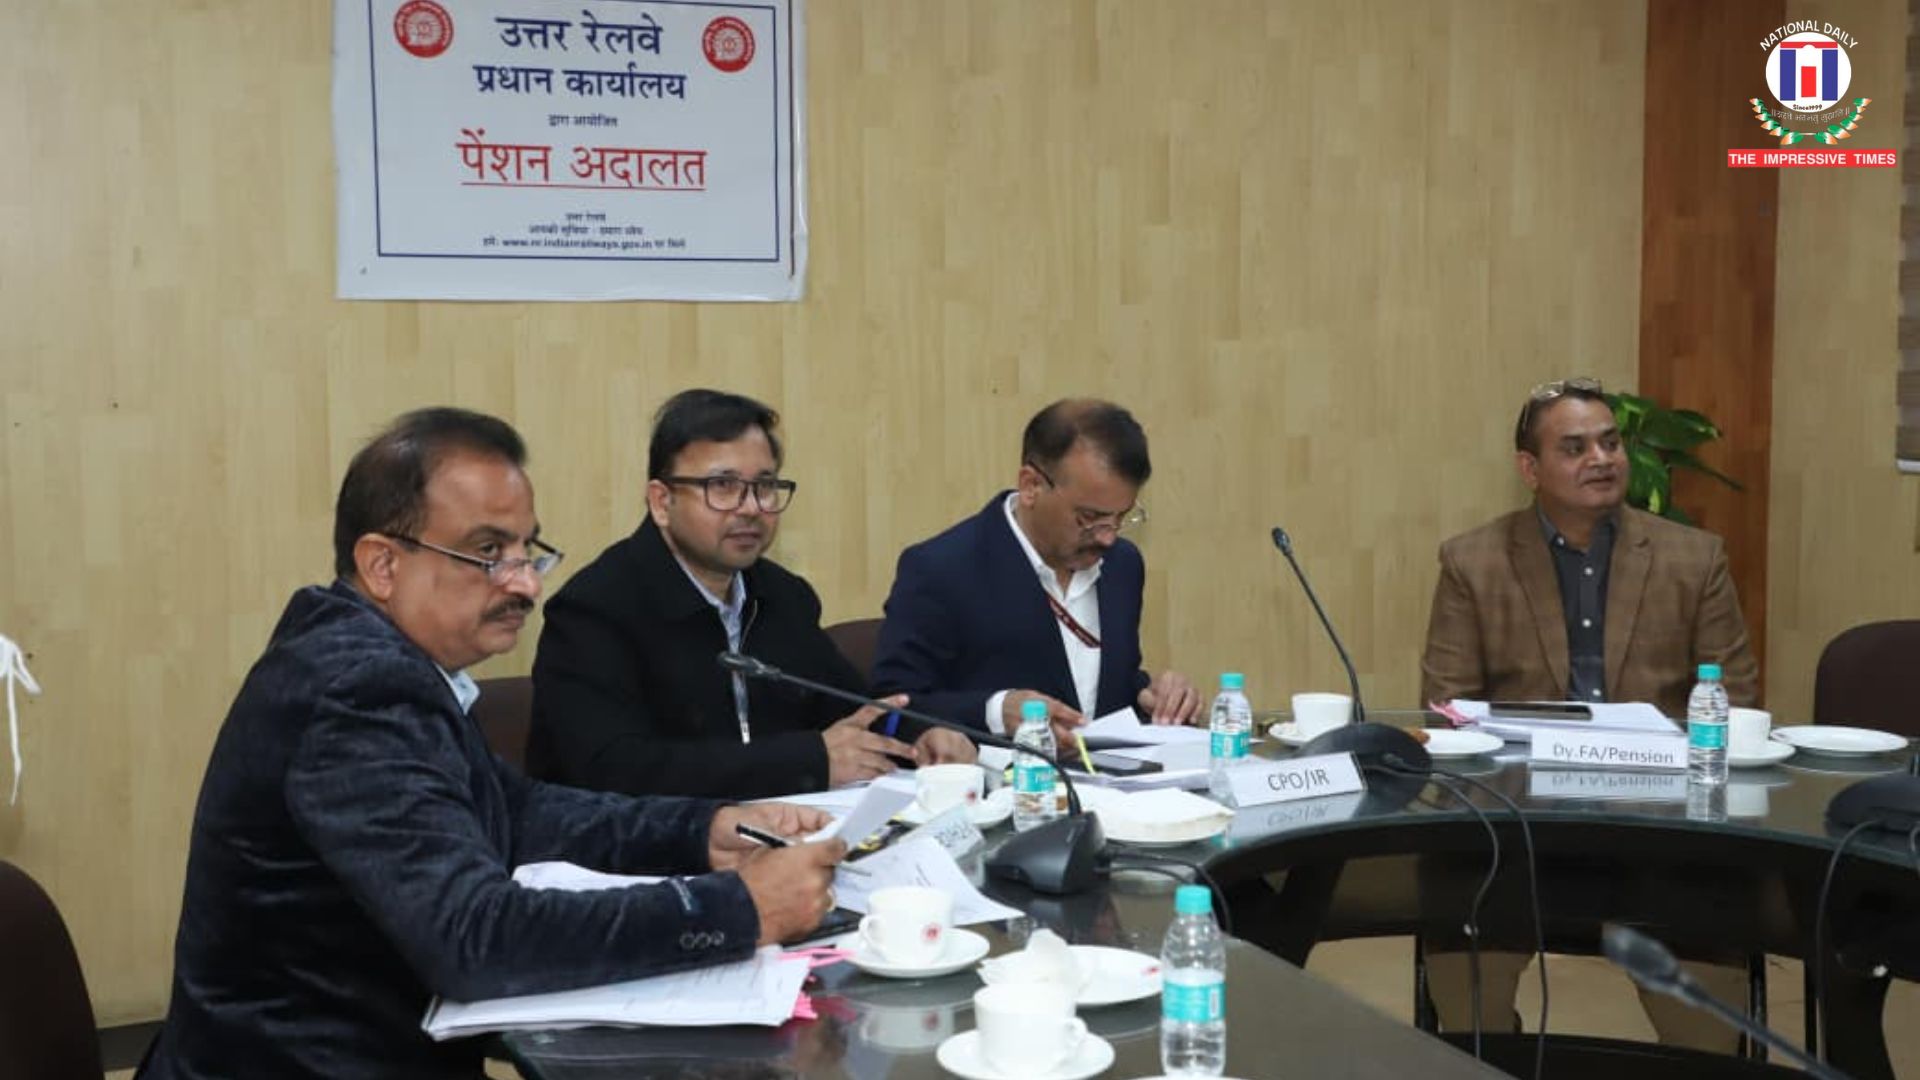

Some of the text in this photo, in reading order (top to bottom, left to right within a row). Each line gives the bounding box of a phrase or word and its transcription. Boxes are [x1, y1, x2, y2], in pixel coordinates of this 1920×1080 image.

[495, 17, 572, 51] उत्तर
[580, 9, 663, 54] रेलवे
[472, 62, 687, 99] प्रधान कार्यालय
[455, 128, 708, 187] पेंशन अदालत
[1267, 768, 1330, 792] CPO/IR
